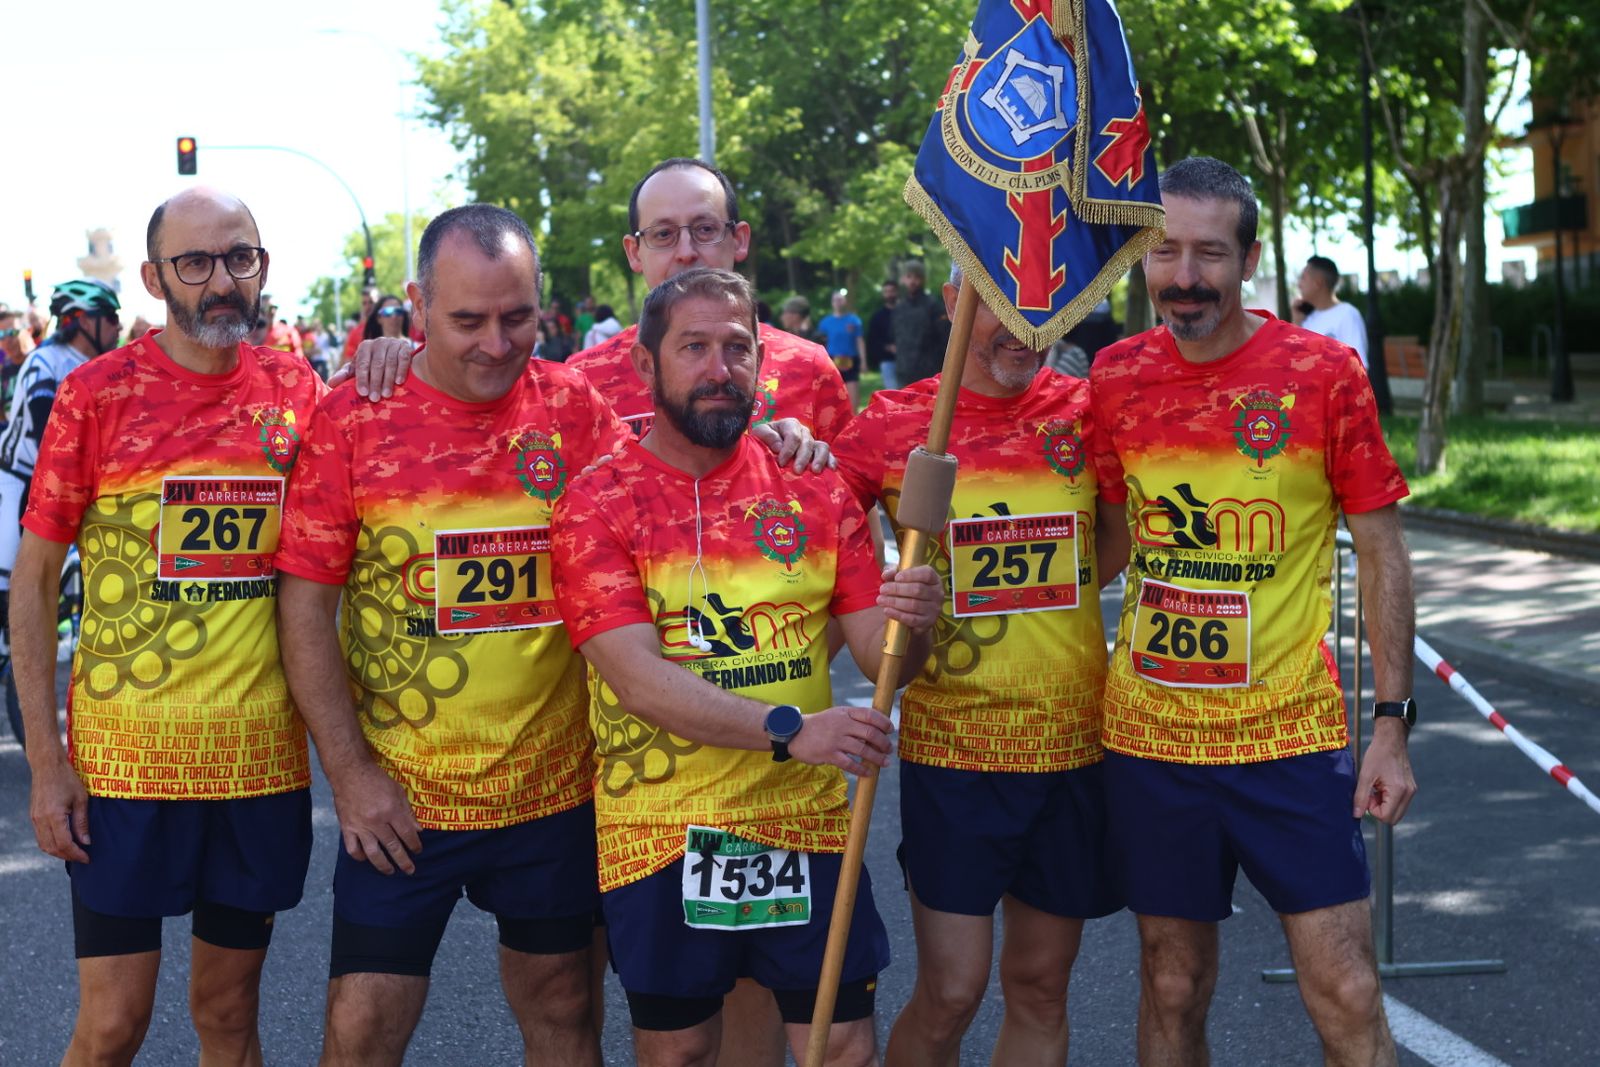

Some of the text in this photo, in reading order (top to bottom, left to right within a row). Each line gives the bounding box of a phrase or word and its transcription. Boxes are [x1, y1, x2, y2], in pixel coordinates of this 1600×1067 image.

[1035, 169, 1062, 188] PLMS
[167, 483, 196, 502] XIV
[199, 491, 254, 502] CARRERA
[180, 507, 267, 551] 267
[955, 524, 983, 543] XIV
[987, 528, 1042, 541] CARRERA
[439, 535, 470, 555] XIV
[472, 541, 529, 554] CARRERA
[972, 542, 1057, 588] 257
[1165, 558, 1243, 582] FERNANDO
[457, 555, 537, 604] 291
[151, 580, 181, 602] SAN
[1143, 584, 1164, 606] XIV
[1163, 598, 1214, 614] CARRERA
[407, 617, 436, 637] SAN
[1147, 611, 1229, 660] 266
[702, 661, 787, 690] FERNANDO
[168, 706, 188, 720] POR
[192, 706, 203, 720] EL
[976, 709, 1010, 724] LEALTAD
[1241, 716, 1260, 729] POR
[1263, 712, 1273, 726] EL
[1278, 703, 1315, 723] TRABAJO
[124, 720, 160, 735] LEALTAD
[175, 721, 203, 735] VALOR
[208, 721, 227, 735] POR
[231, 720, 241, 735] EL
[961, 722, 1007, 737] FORTALEZA
[1011, 725, 1043, 738] LEALTAD
[1149, 726, 1195, 744] FORTALEZA
[1199, 730, 1236, 745] LEALTAD
[1248, 725, 1277, 742] VALOR
[1280, 722, 1299, 737] POR
[1302, 718, 1312, 731] EL
[109, 732, 157, 750] FORTALEZA
[161, 736, 200, 750] LEALTAD
[204, 736, 210, 750] Y
[214, 735, 241, 750] VALOR
[245, 733, 261, 748] POR
[441, 744, 460, 757] POR
[955, 735, 1073, 752] VICTORIA FORTALEZA LEALTAD
[1157, 743, 1192, 758] LEALTAD
[1205, 745, 1234, 759] VALOR
[1236, 744, 1256, 758] POR
[1259, 742, 1271, 755] EL
[1274, 732, 1318, 752] TRABAJO
[102, 746, 140, 764] VICTORIA
[144, 751, 197, 765] FORTALEZA
[201, 750, 237, 765] LEALTAD
[250, 746, 272, 761] VALOR
[953, 748, 1000, 764] FORTALEZA
[1004, 751, 1038, 764] LEALTAD
[124, 763, 134, 779] LA
[138, 766, 179, 781] VICTORIA
[183, 765, 234, 781] FORTALEZA
[238, 760, 269, 779] LEALTAD
[514, 758, 532, 774] POR
[92, 777, 132, 793] VICTORIA
[136, 780, 189, 796] FORTALEZA
[192, 780, 230, 796] LEALTAD
[243, 777, 266, 794] VALOR
[415, 778, 468, 797] FORTALEZA
[471, 779, 509, 796] LEALTAD
[454, 794, 507, 808] FORTALEZA
[511, 783, 542, 805] LEALTAD
[415, 805, 460, 822] ORTALEZA
[464, 808, 501, 822] LEALTAD
[515, 800, 541, 816] VALOR
[784, 830, 801, 845] POR
[725, 842, 763, 854] CARRE
[691, 851, 806, 901] 1534
